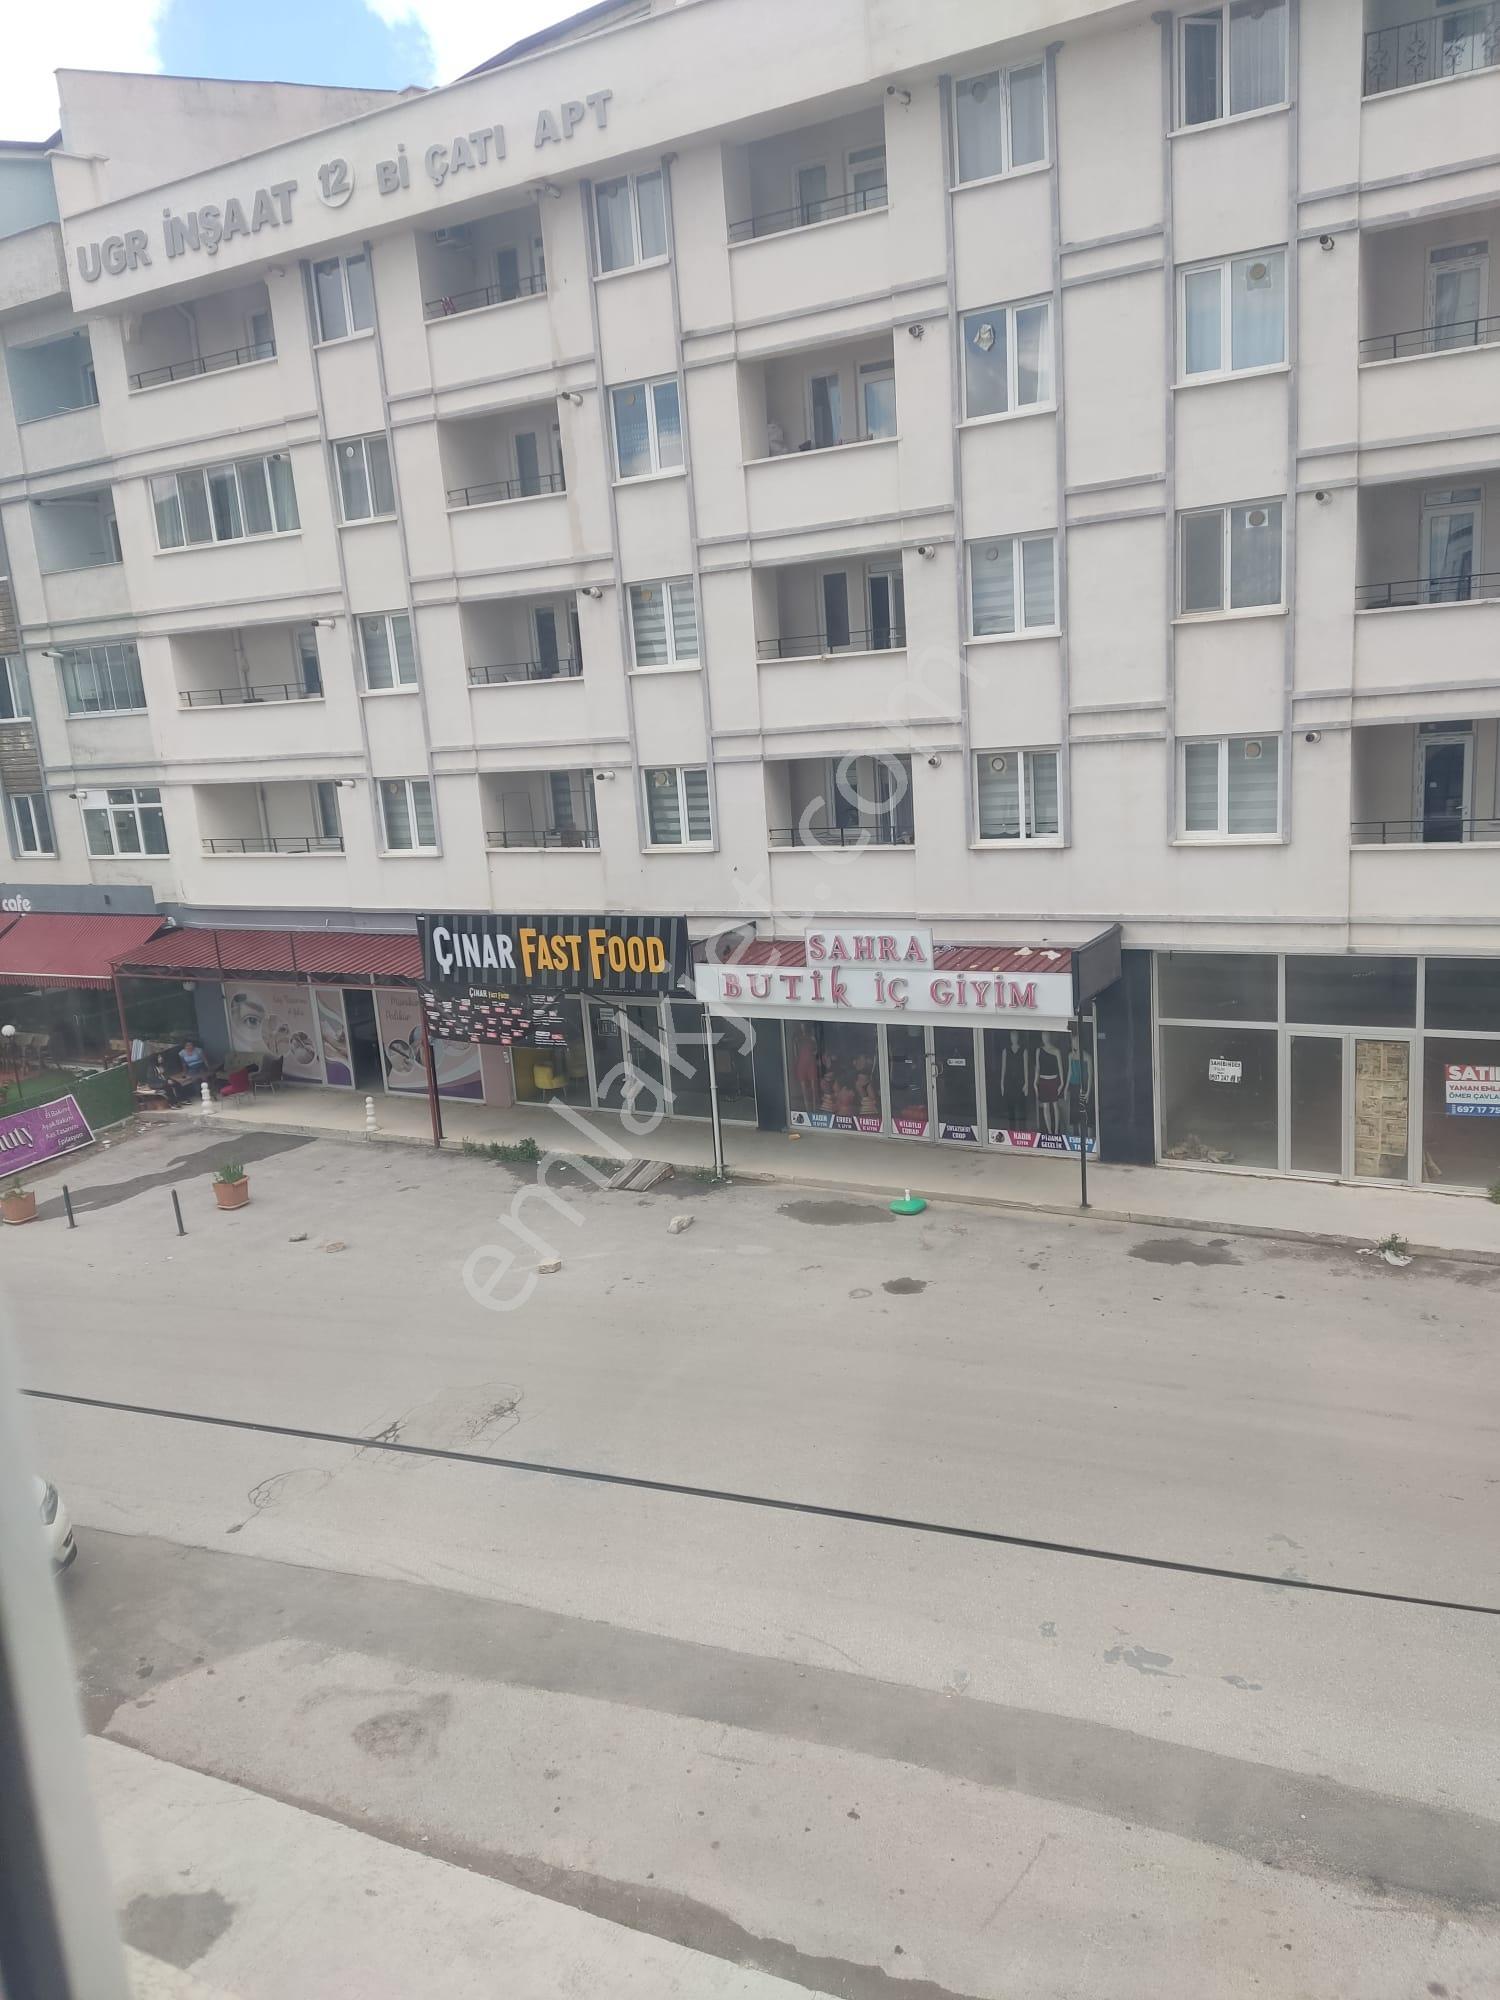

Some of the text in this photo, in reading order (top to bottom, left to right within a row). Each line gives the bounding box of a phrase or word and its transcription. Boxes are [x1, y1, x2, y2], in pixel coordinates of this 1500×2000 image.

[76, 229, 152, 282] UGR
[163, 180, 298, 259] İNŞAAT
[317, 158, 350, 198] 12
[424, 125, 506, 187] ÇATI
[534, 89, 613, 148] APT
[2, 894, 32, 912] cafe
[432, 926, 666, 980] ÇINAR FAST FOOD
[808, 934, 927, 963] SAHRA
[874, 971, 909, 1010] İÇ
[929, 973, 1038, 1010] GİYİM
